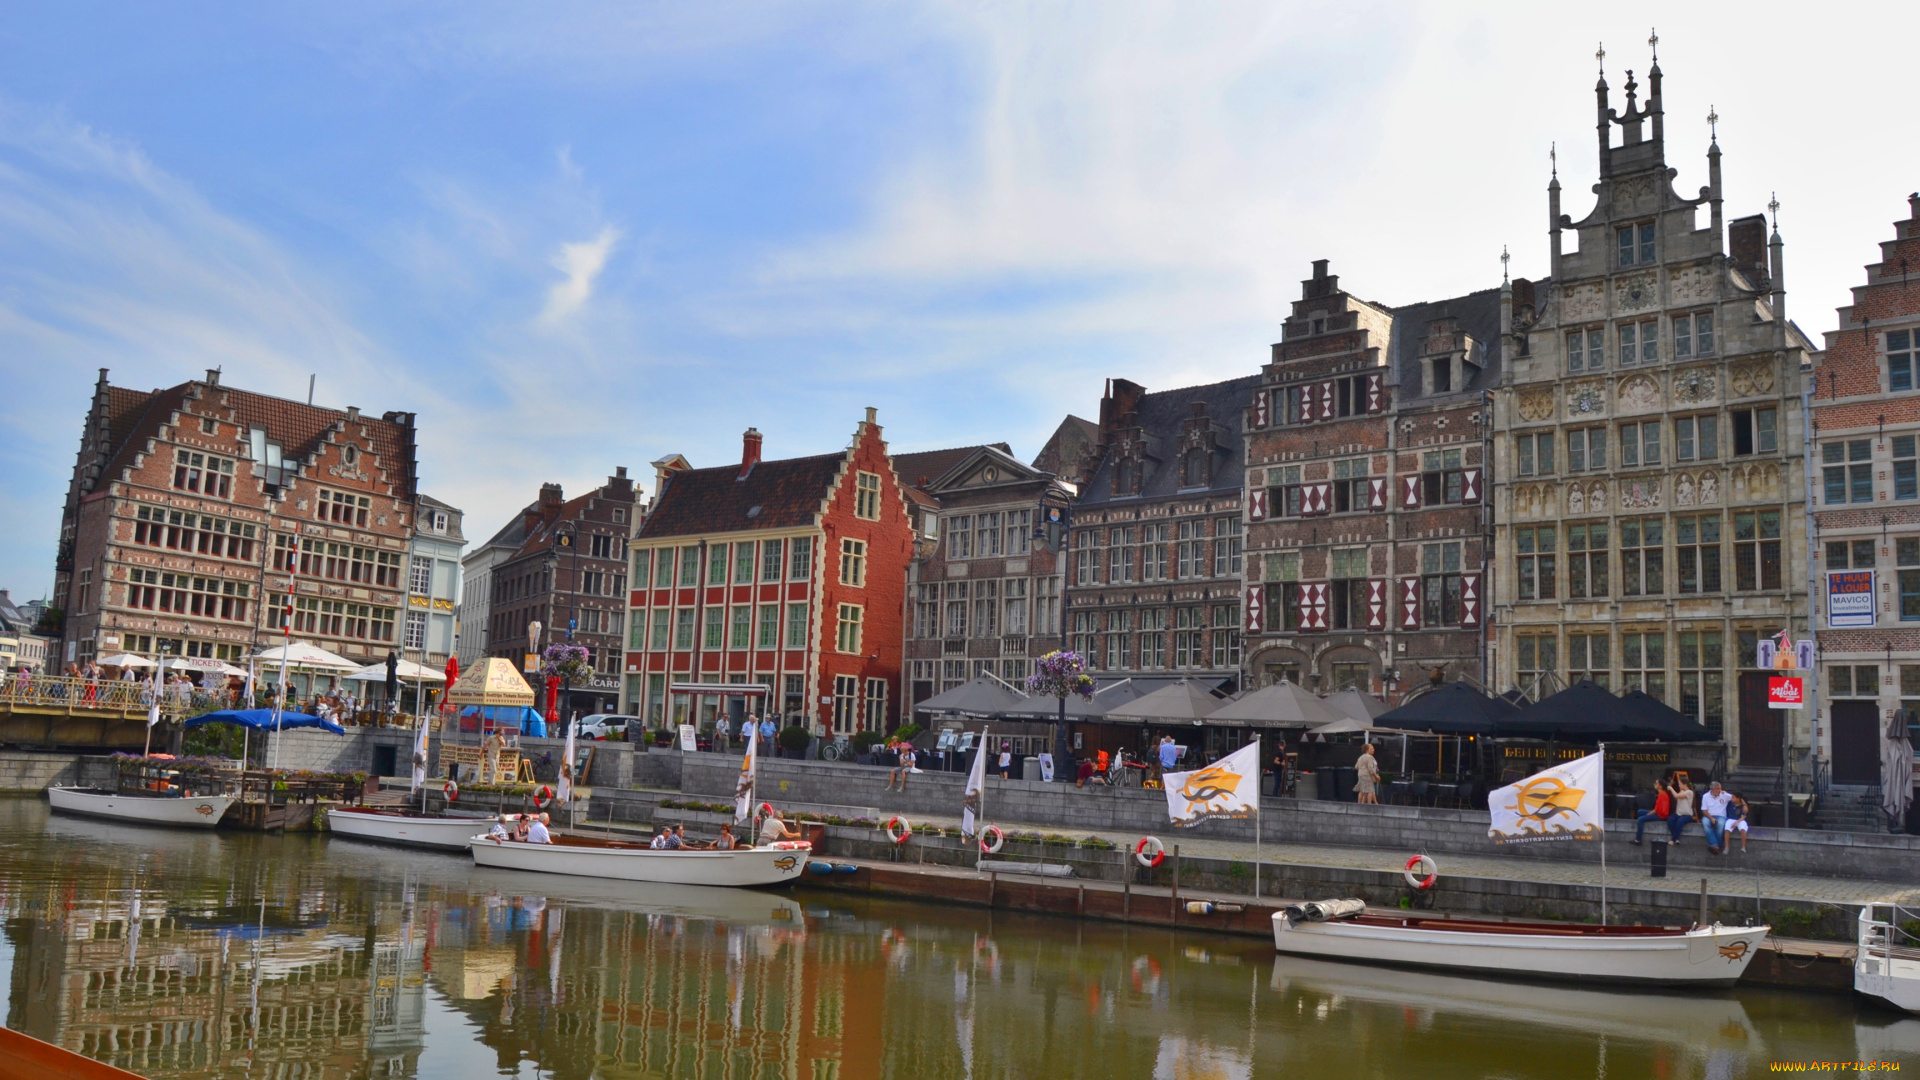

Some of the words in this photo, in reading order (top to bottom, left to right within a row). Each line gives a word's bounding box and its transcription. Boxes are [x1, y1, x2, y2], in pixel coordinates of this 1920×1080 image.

[1831, 574, 1841, 583] TE
[1843, 572, 1871, 583] HUUR
[1831, 585, 1838, 593] A
[1841, 583, 1871, 593] LOUER
[1833, 596, 1869, 604] MAVICO
[191, 659, 222, 668] TICKETS
[590, 679, 620, 689] ICARD
[1616, 753, 1668, 762] RESTAURANT
